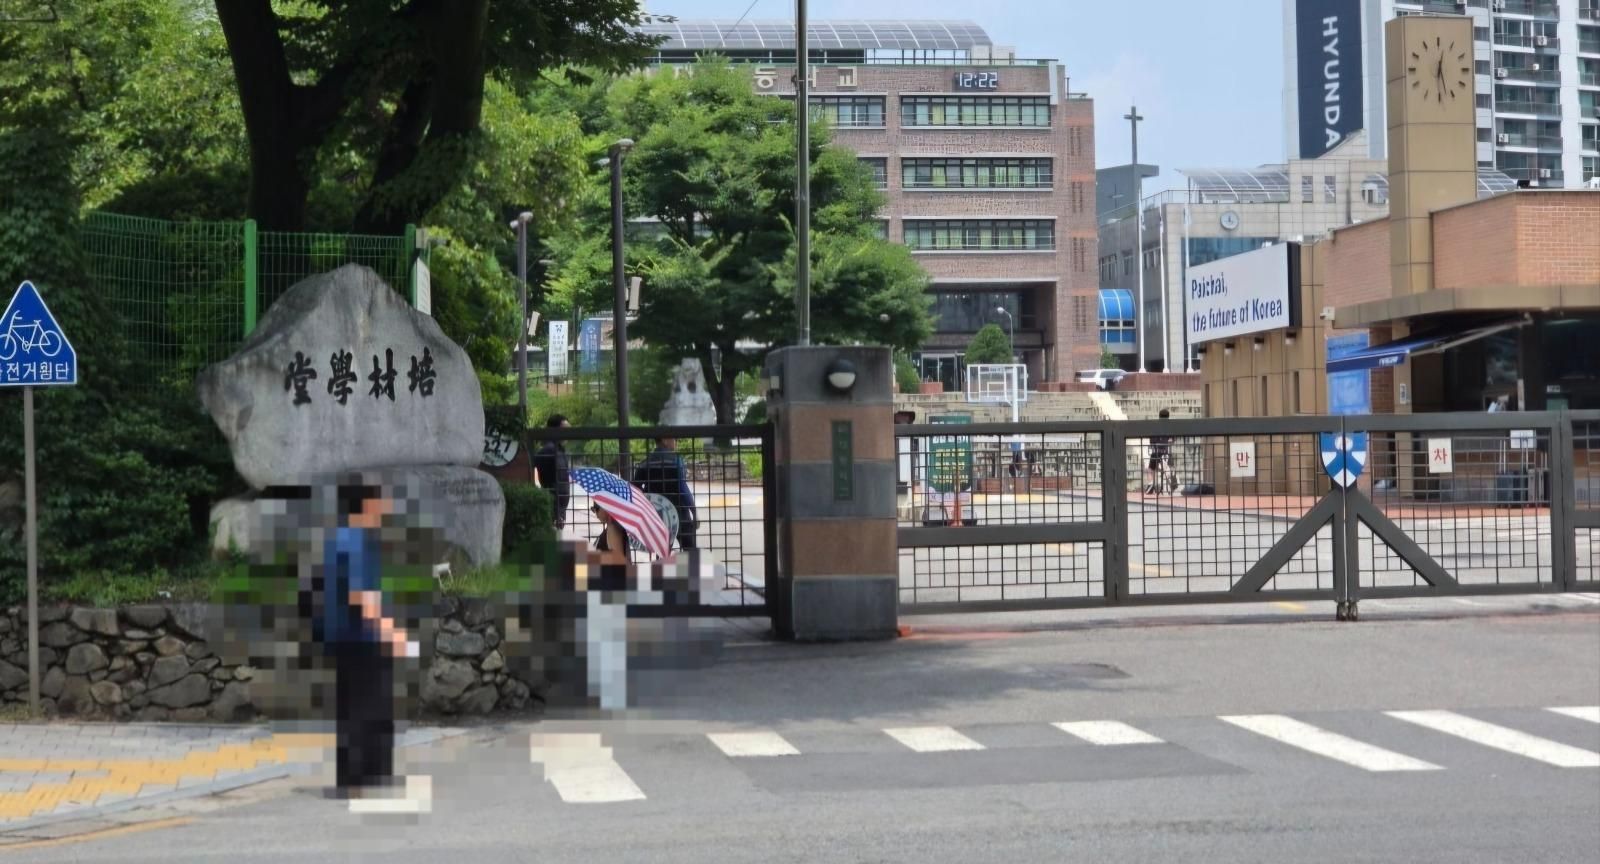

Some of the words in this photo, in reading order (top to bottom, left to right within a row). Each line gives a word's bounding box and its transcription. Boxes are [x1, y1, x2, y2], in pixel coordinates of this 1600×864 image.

[959, 72, 998, 88] 12:22
[1322, 16, 1341, 149] HYUNDA
[1191, 271, 1228, 300] Paichai,
[1193, 311, 1207, 332] the
[1209, 306, 1237, 329] future
[1239, 300, 1249, 324] of
[1252, 298, 1282, 322] Korea
[1236, 451, 1250, 468] 만
[1434, 447, 1448, 465] 차
